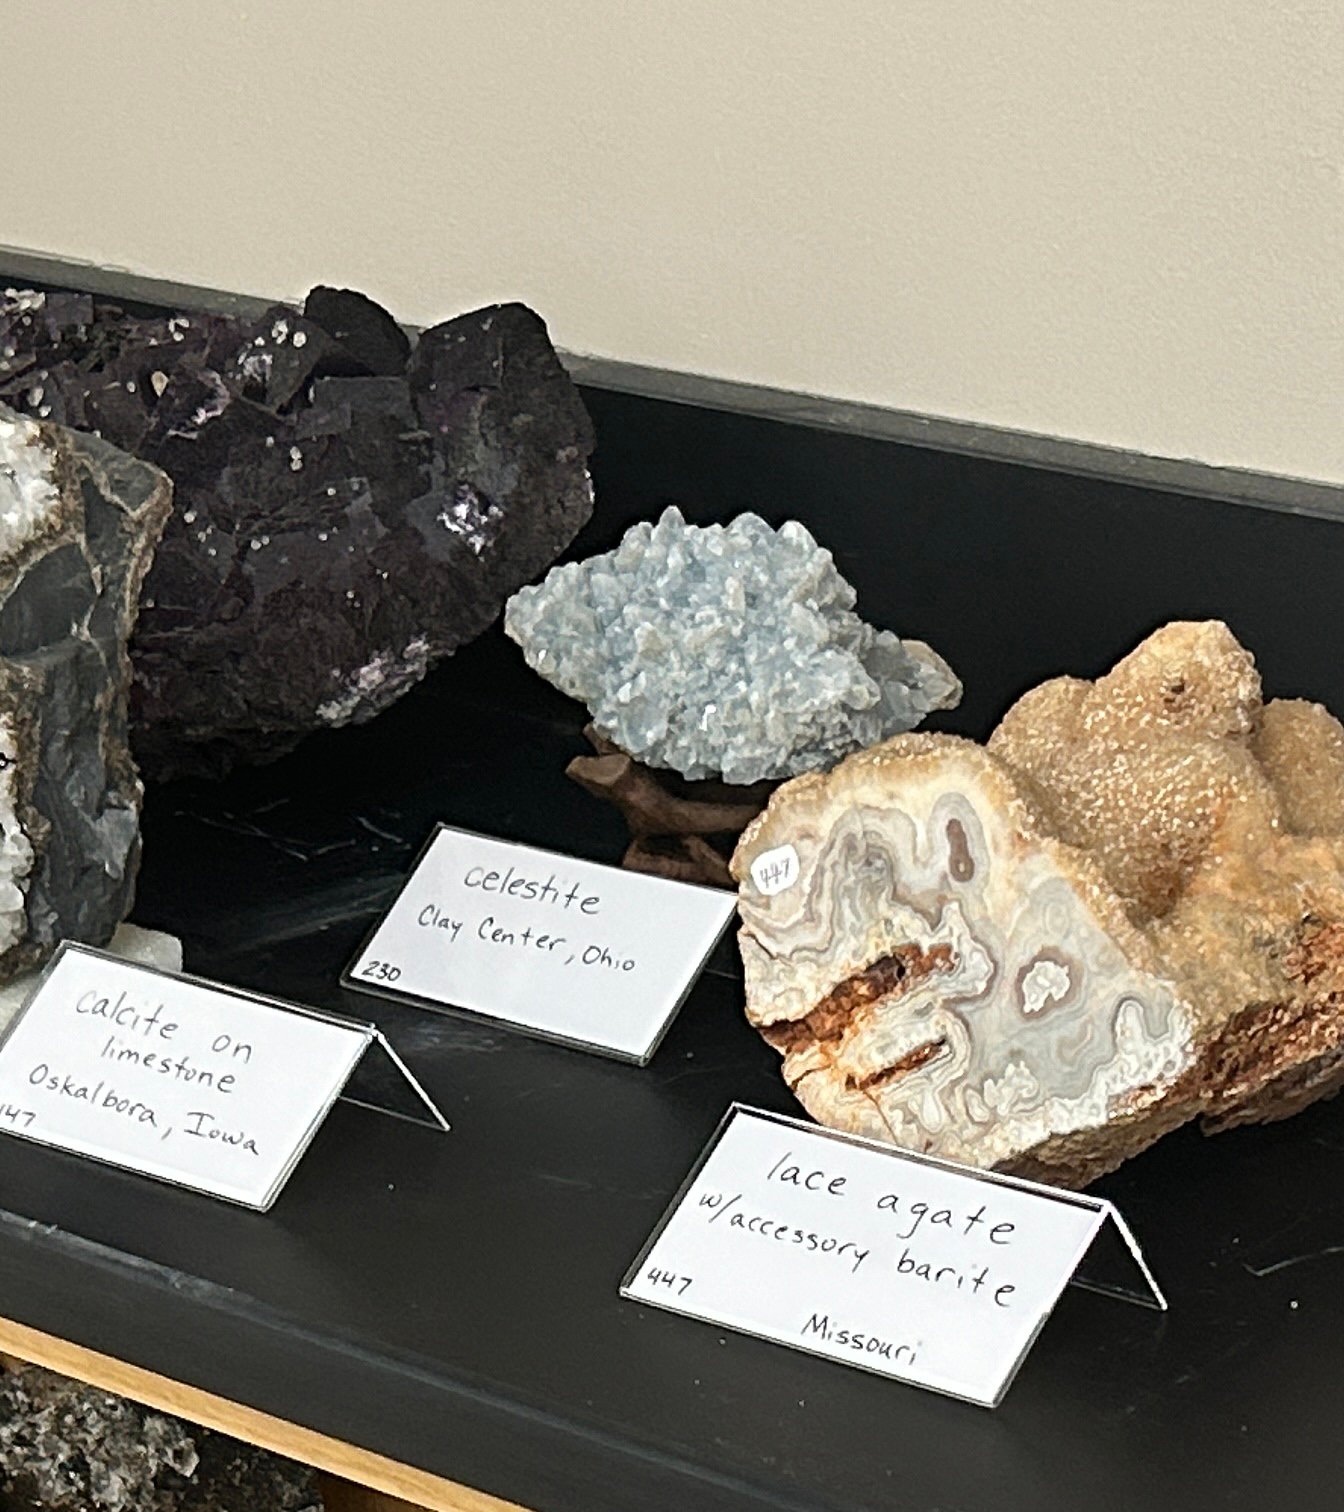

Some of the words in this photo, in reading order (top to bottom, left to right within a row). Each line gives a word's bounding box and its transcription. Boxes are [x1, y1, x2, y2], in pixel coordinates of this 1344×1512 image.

[759, 856, 791, 889] 447
[419, 904, 462, 941] Clay
[582, 945, 635, 972] Ohio
[362, 960, 401, 982] 230
[101, 1036, 236, 1094] limestone
[212, 1033, 252, 1064] on
[182, 1111, 259, 1156] Iowa
[767, 1152, 848, 1196] lace
[877, 1193, 1016, 1245] agate
[700, 1192, 870, 1273] w/accessory
[897, 1247, 1016, 1308] barite
[647, 1267, 693, 1295] 447
[801, 1313, 923, 1365] Missouri
